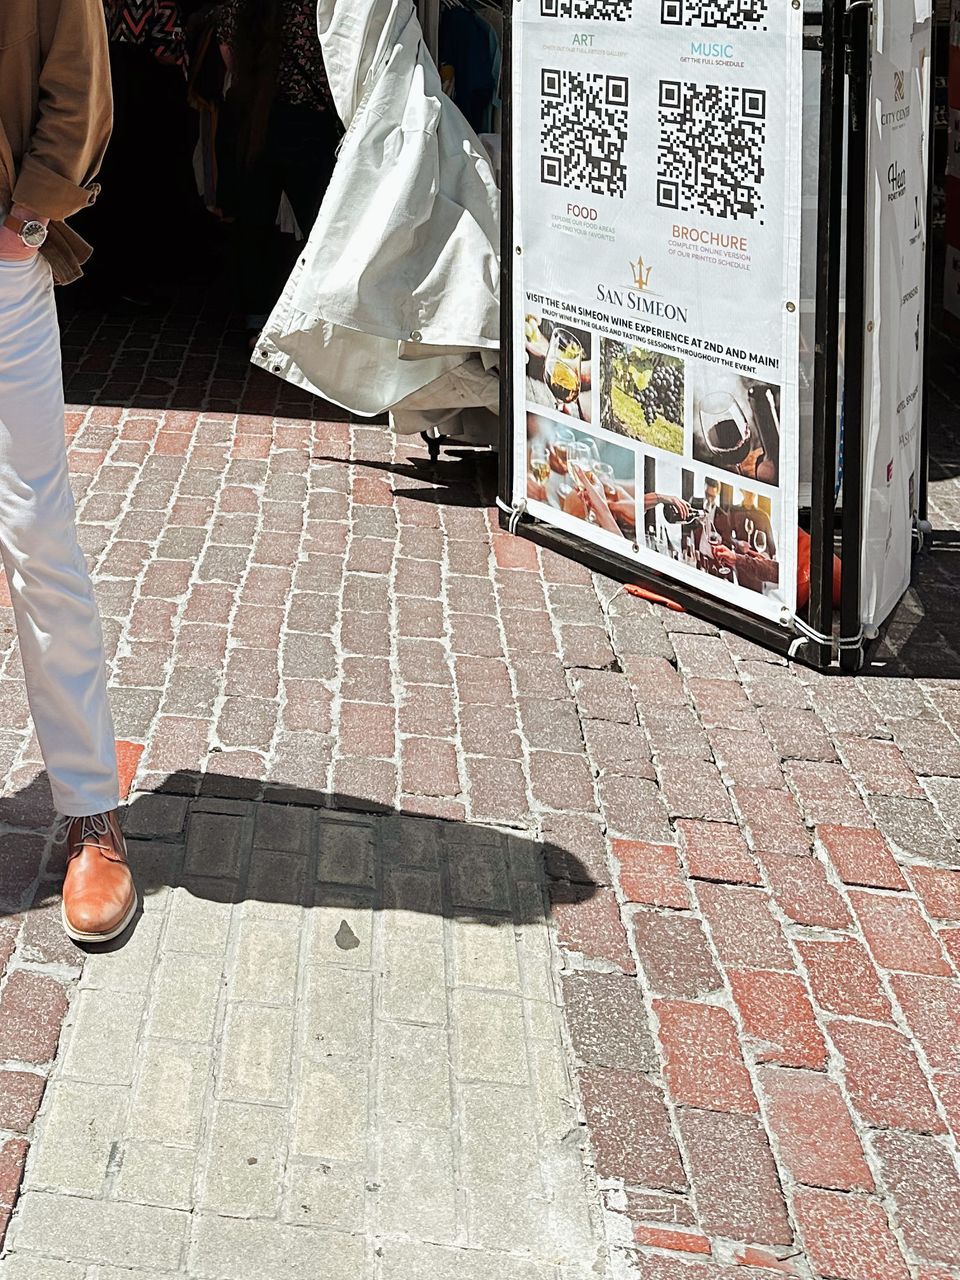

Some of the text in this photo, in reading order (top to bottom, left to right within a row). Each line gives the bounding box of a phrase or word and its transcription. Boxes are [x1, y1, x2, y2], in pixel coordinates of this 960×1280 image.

[572, 33, 595, 46] ART
[691, 42, 733, 58] MUSIC
[715, 59, 744, 68] SCHEDULE
[567, 203, 598, 221] FOOD
[672, 225, 747, 252] BROCHURE
[668, 240, 751, 262] COMPLETE ONLINE VERSION
[677, 250, 690, 258] OUR
[692, 253, 717, 264] PRINTED
[718, 258, 751, 271] SCHEDULE
[597, 283, 688, 323] SAN SIMEON
[526, 291, 779, 369] VISIT THE SAN SIMEON WINE EXPERIENCE AT 2ND AND MAIN!
[542, 308, 558, 318] ENJOY
[559, 312, 572, 322] WINE
[581, 318, 590, 328] THE
[591, 322, 609, 333] GLASS
[610, 327, 622, 337] AND
[623, 330, 646, 343] TASTING
[647, 338, 675, 352] SESSIONS
[677, 346, 721, 364] THROUGHOUT
[721, 358, 734, 368] THE
